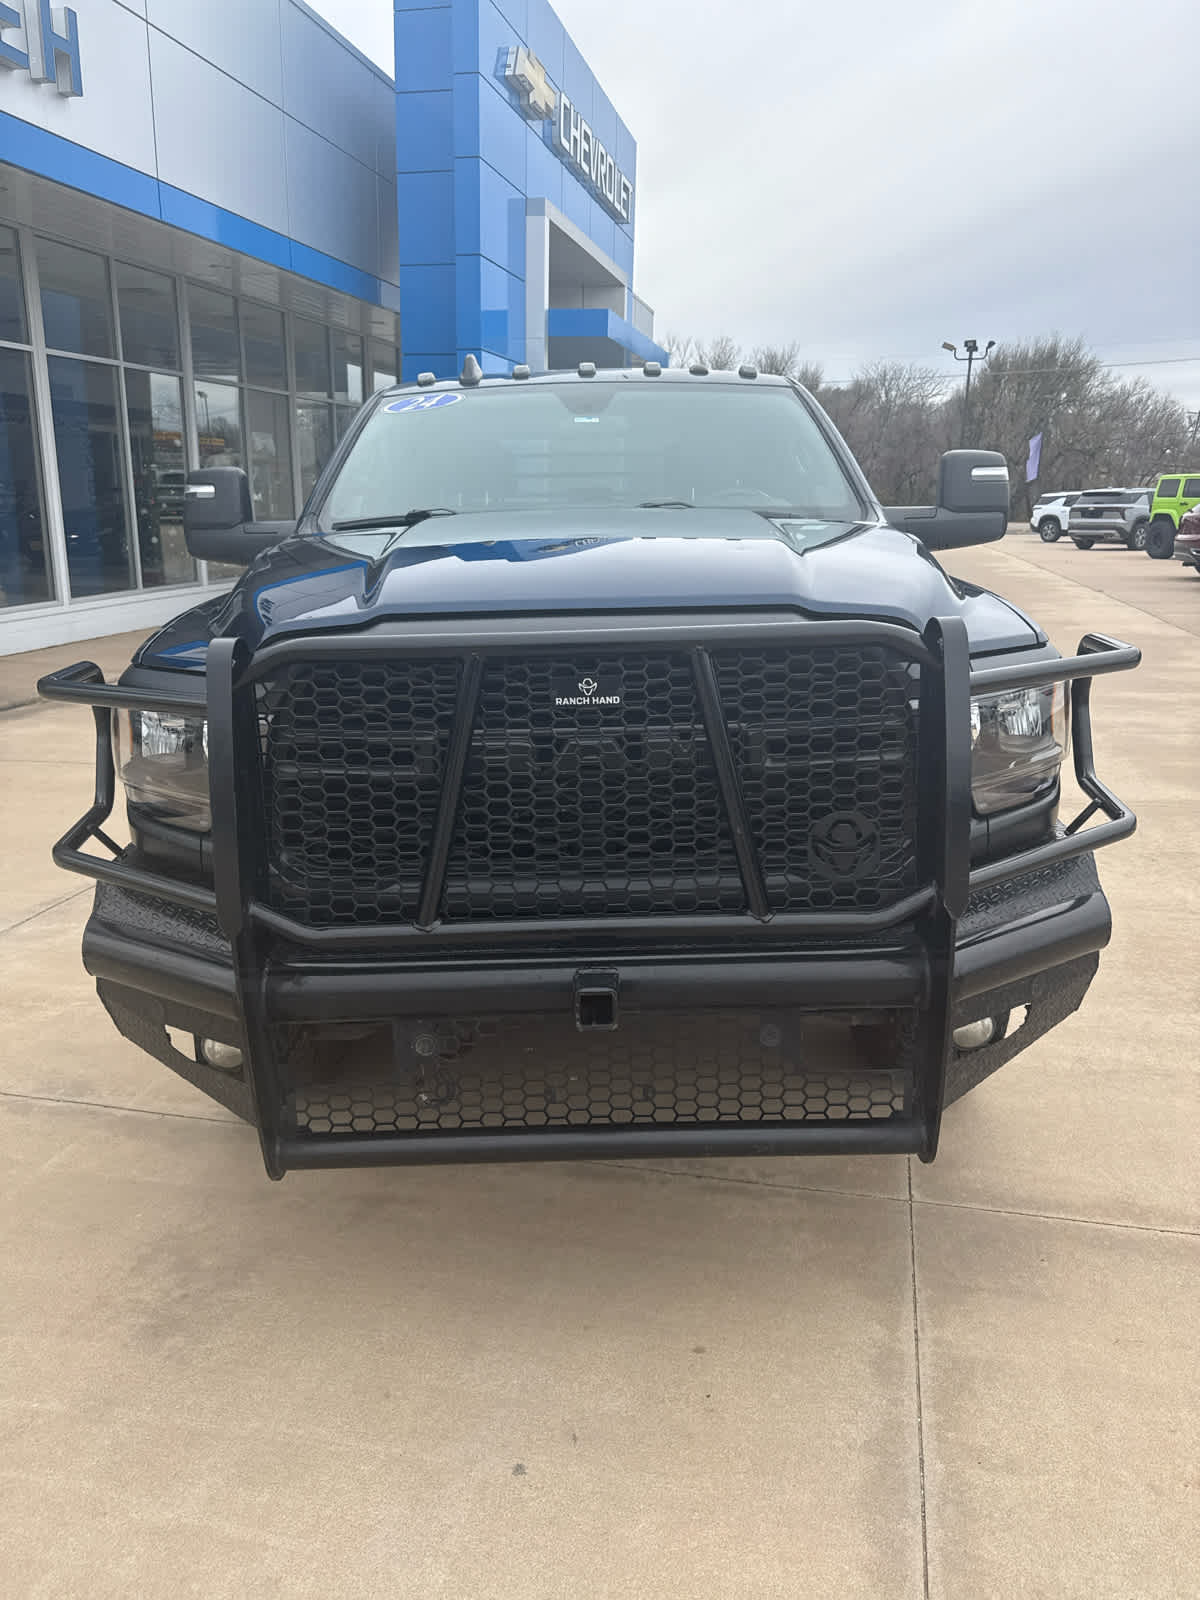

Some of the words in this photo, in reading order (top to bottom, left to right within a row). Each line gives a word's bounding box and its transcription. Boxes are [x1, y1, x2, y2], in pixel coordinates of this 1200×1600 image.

[560, 92, 633, 222] CHEVROLET
[555, 697, 590, 705] RANCH
[592, 696, 620, 704] HAND
